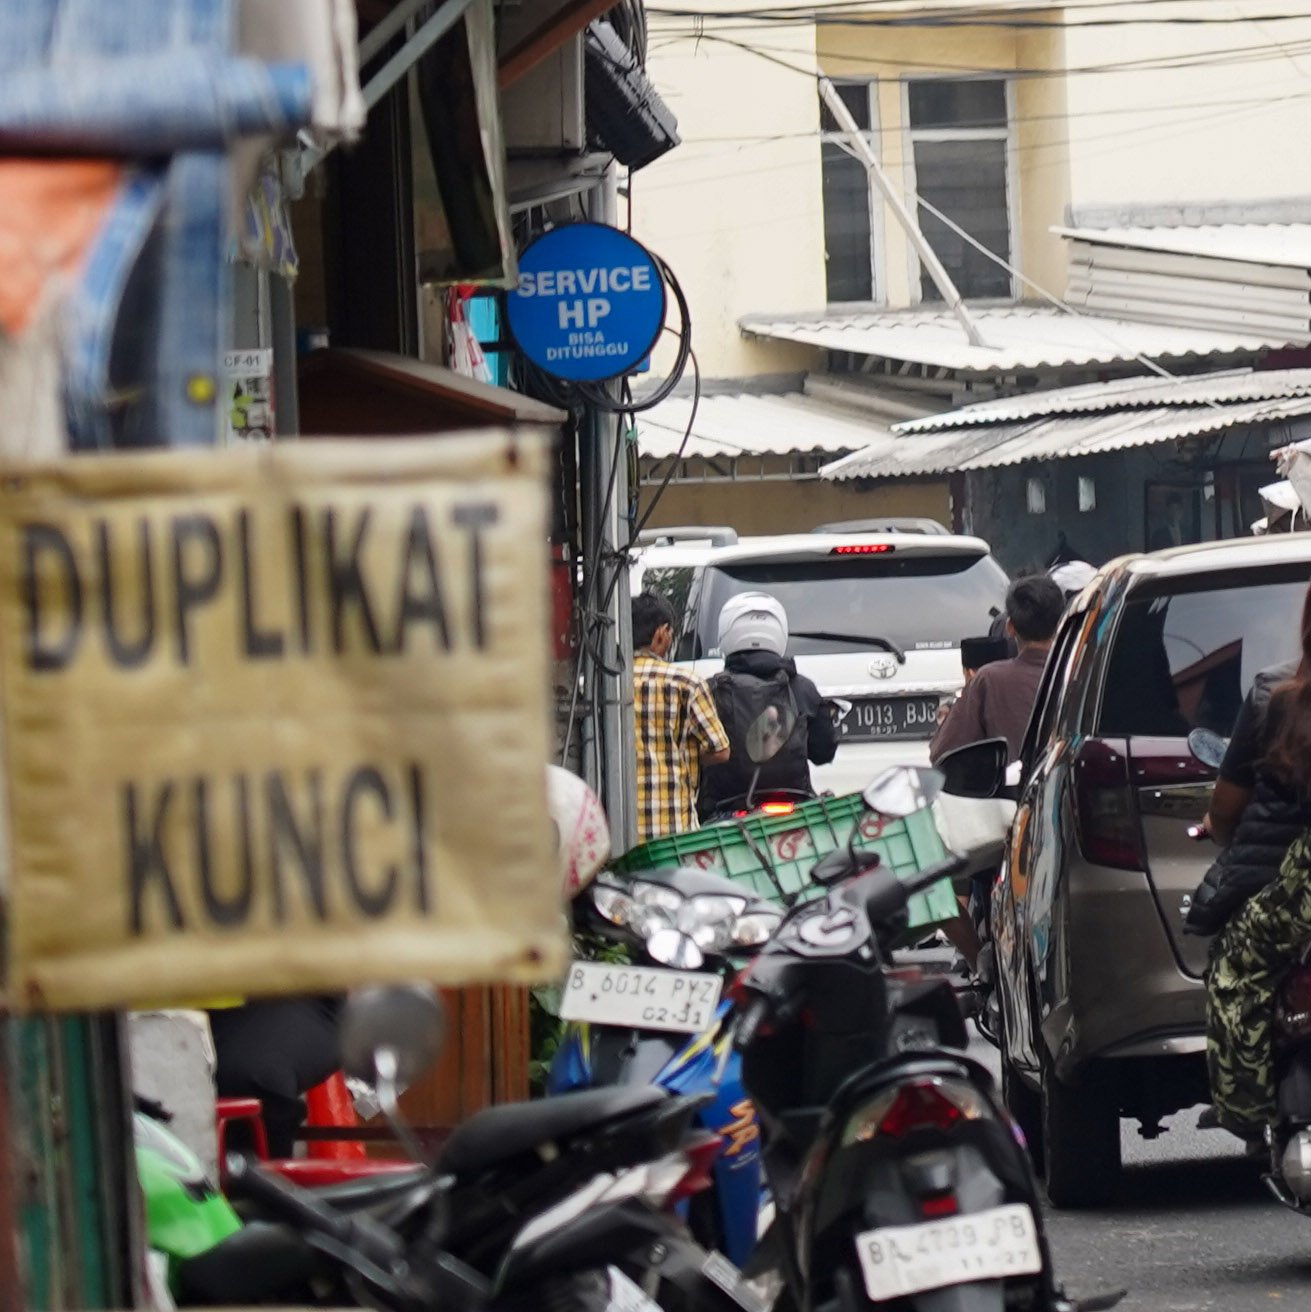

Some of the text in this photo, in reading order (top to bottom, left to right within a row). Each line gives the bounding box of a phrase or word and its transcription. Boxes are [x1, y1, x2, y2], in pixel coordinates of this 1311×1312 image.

[517, 265, 651, 299] SERVICE
[557, 299, 612, 330] HP
[546, 341, 629, 362] DITUNGGU
[568, 331, 606, 347] BISA
[17, 503, 500, 673] DUPLIKAT
[856, 703, 893, 726] 1013
[118, 762, 433, 937] KUNCI
[572, 969, 585, 989] B
